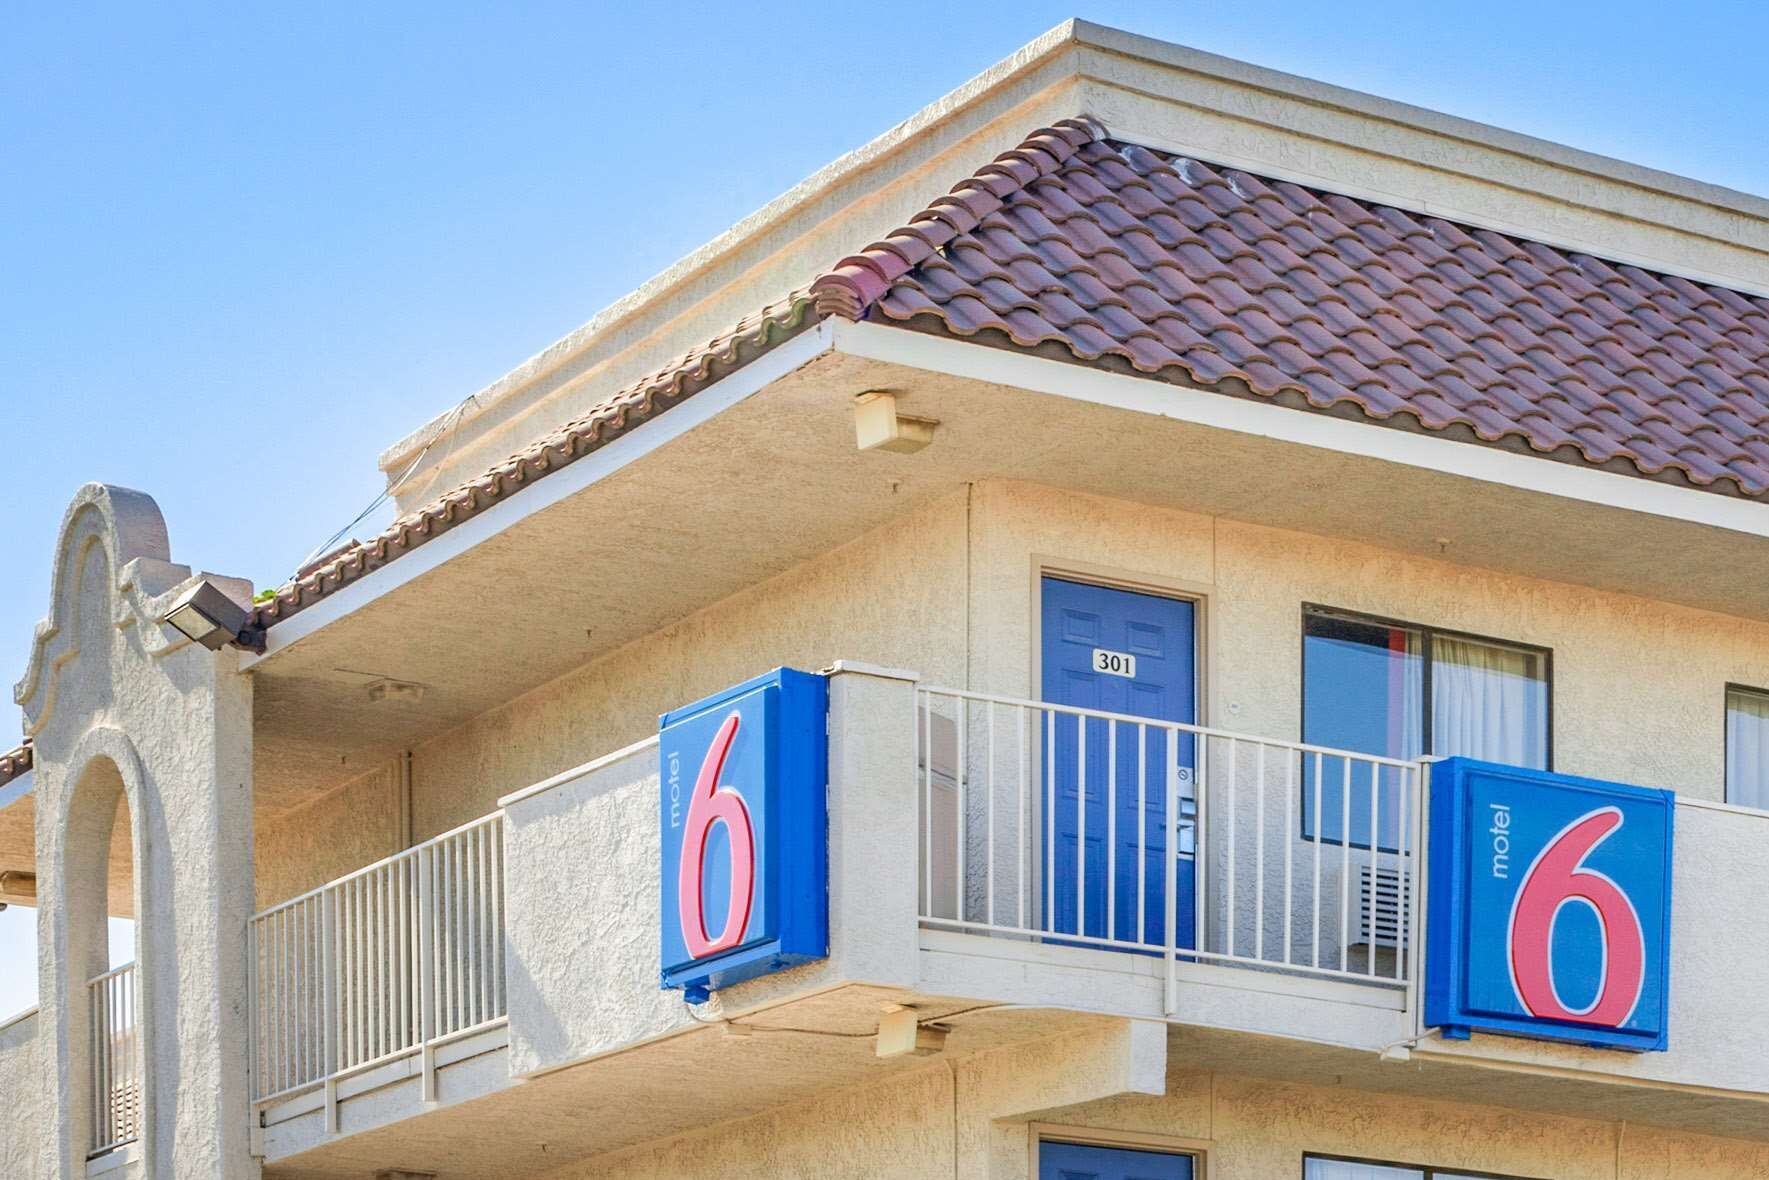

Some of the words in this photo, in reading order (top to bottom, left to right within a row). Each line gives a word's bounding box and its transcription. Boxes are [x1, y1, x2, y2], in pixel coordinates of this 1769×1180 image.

[1100, 653, 1130, 674] 301
[667, 751, 680, 828] motel
[678, 709, 756, 960] 6
[1489, 803, 1511, 879] motel
[1506, 805, 1646, 1028] 6
